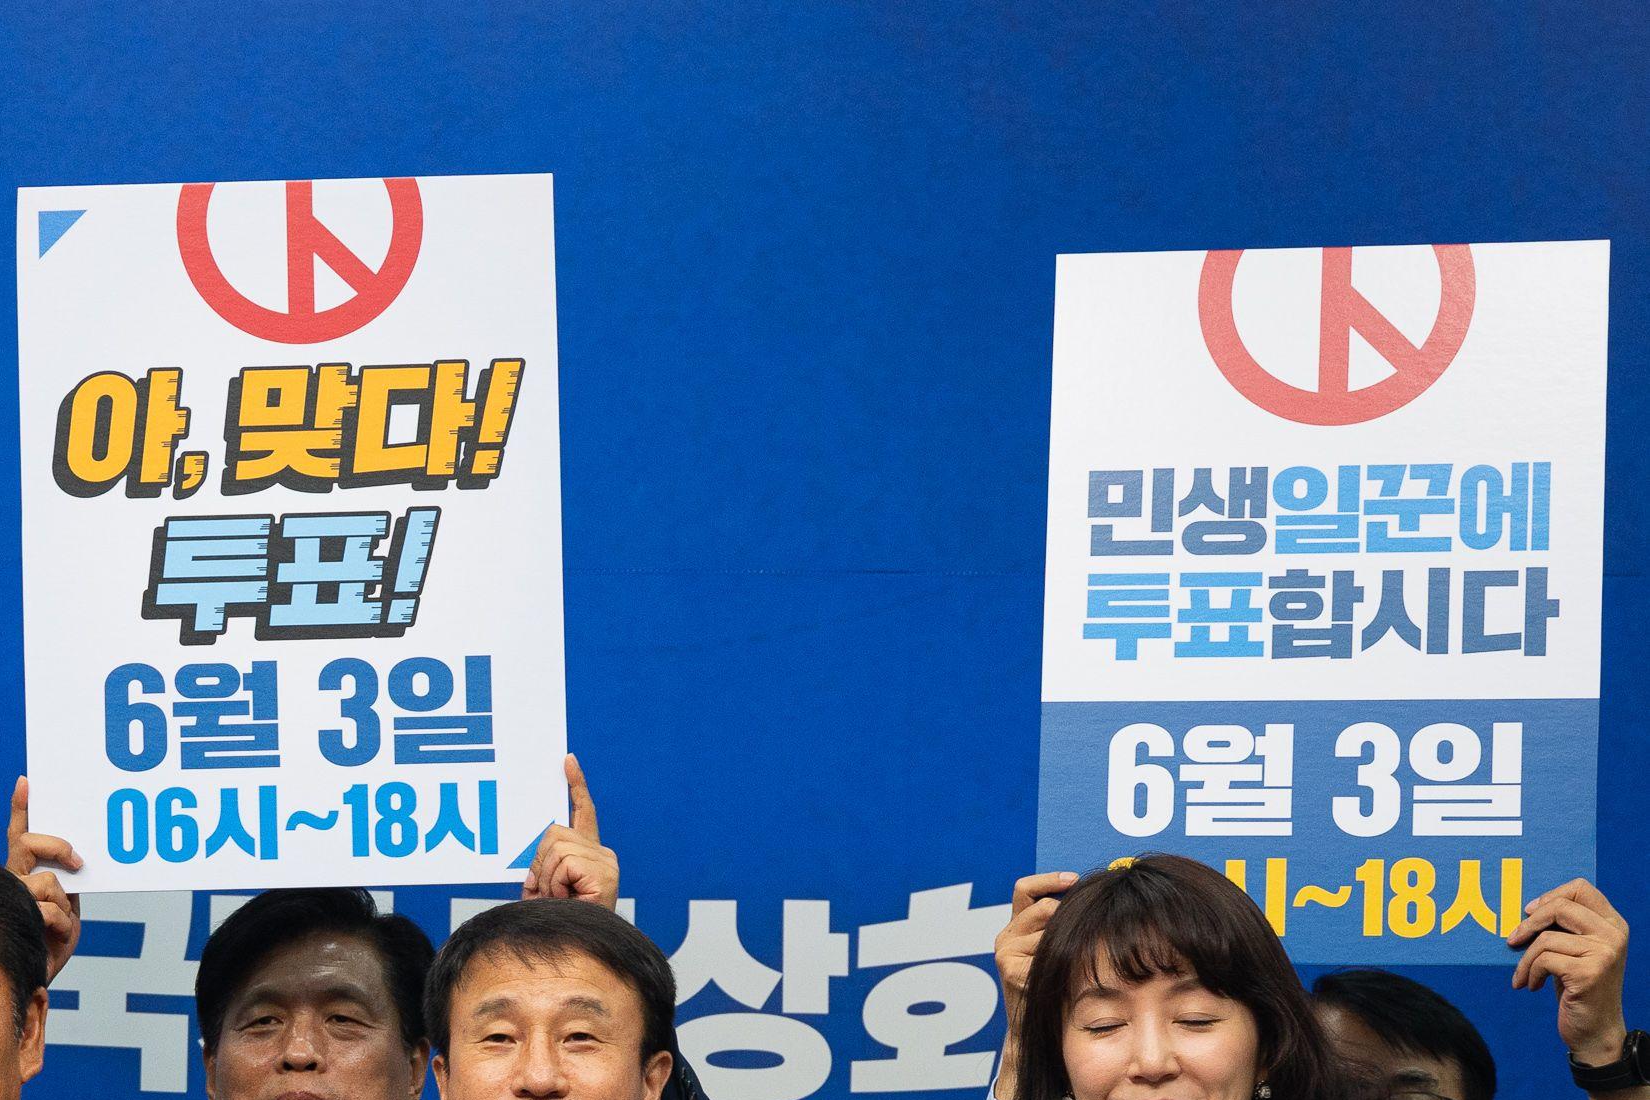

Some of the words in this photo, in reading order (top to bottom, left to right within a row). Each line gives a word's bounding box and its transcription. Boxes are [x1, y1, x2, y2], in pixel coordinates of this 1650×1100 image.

[52, 367, 209, 500] 아,
[221, 357, 525, 496] 맞다!
[1087, 461, 1551, 556] 민생일꾼에
[142, 506, 441, 646] 투표!
[1082, 567, 1560, 661] 투표합시다
[104, 658, 281, 772] 6월
[317, 655, 495, 767] 3일
[107, 780, 499, 864] 06시~18시
[1106, 722, 1295, 838] 6월
[1332, 722, 1523, 838] 3일
